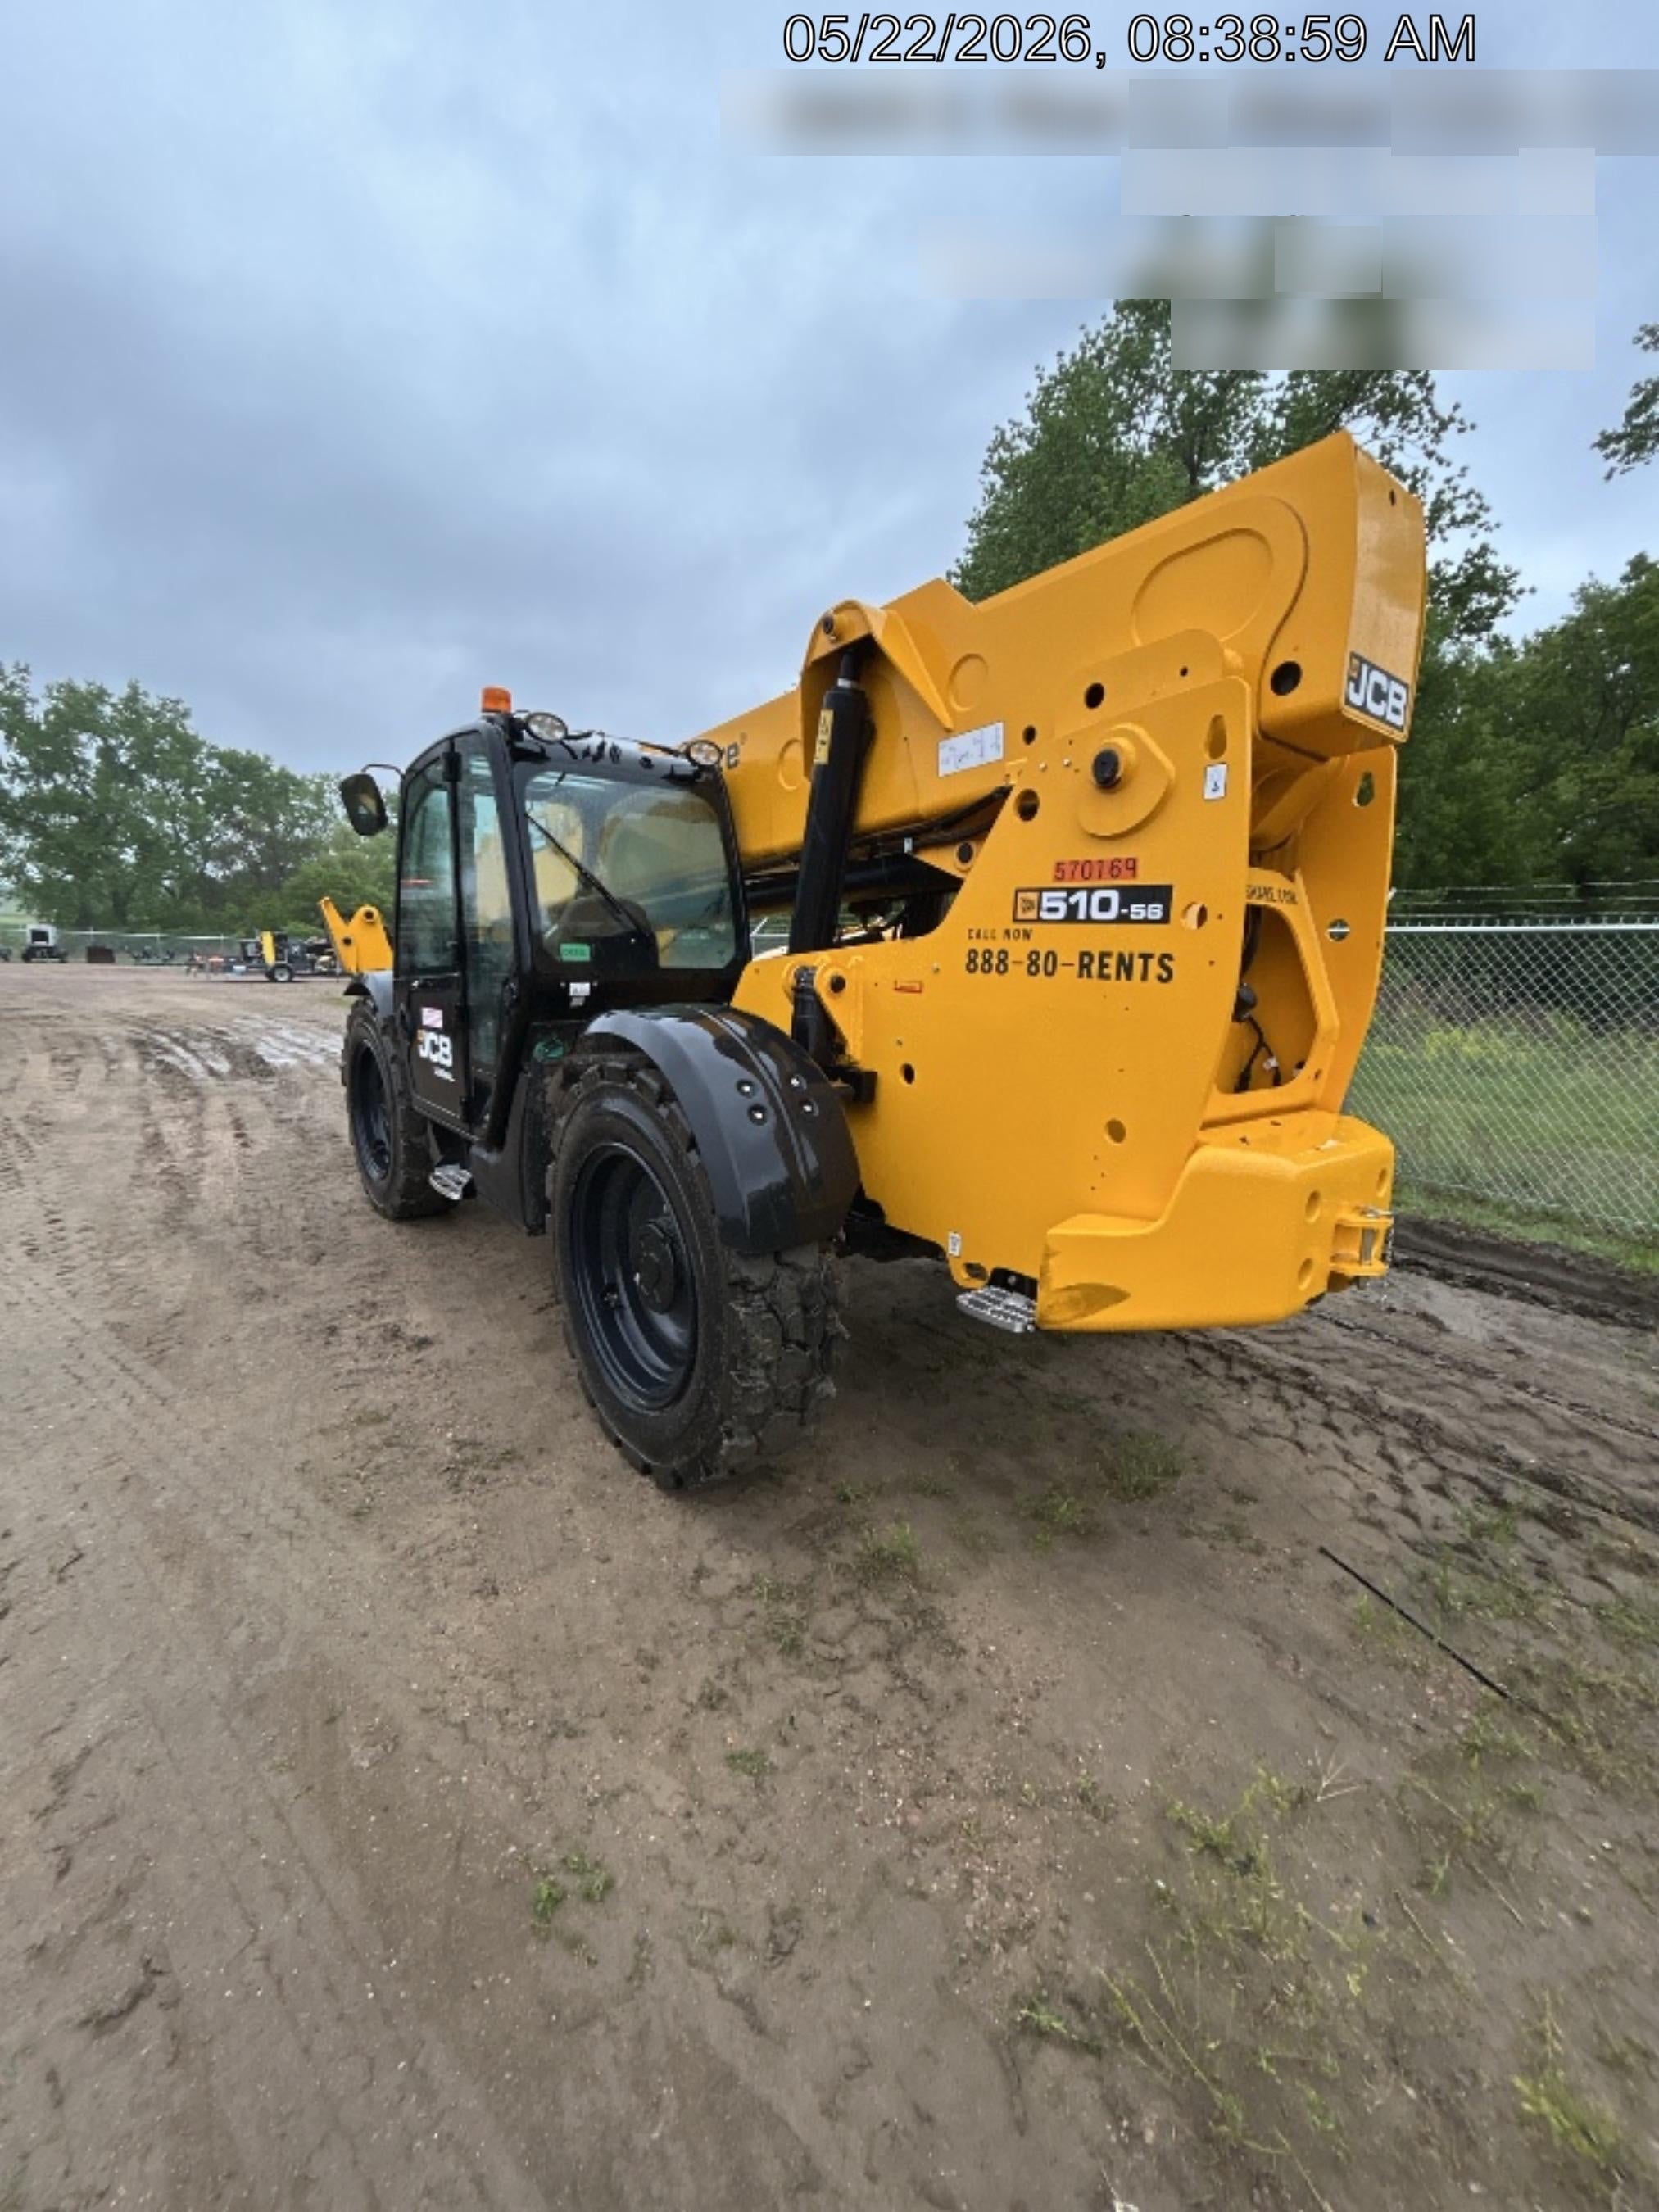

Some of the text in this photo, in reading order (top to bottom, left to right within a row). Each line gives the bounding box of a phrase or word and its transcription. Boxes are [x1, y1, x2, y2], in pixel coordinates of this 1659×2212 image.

[1348, 663, 1407, 727] JCB
[968, 928, 1032, 941] CALL NOW
[965, 948, 1175, 983] 888-80-RENTS
[418, 1031, 453, 1067] JCB
